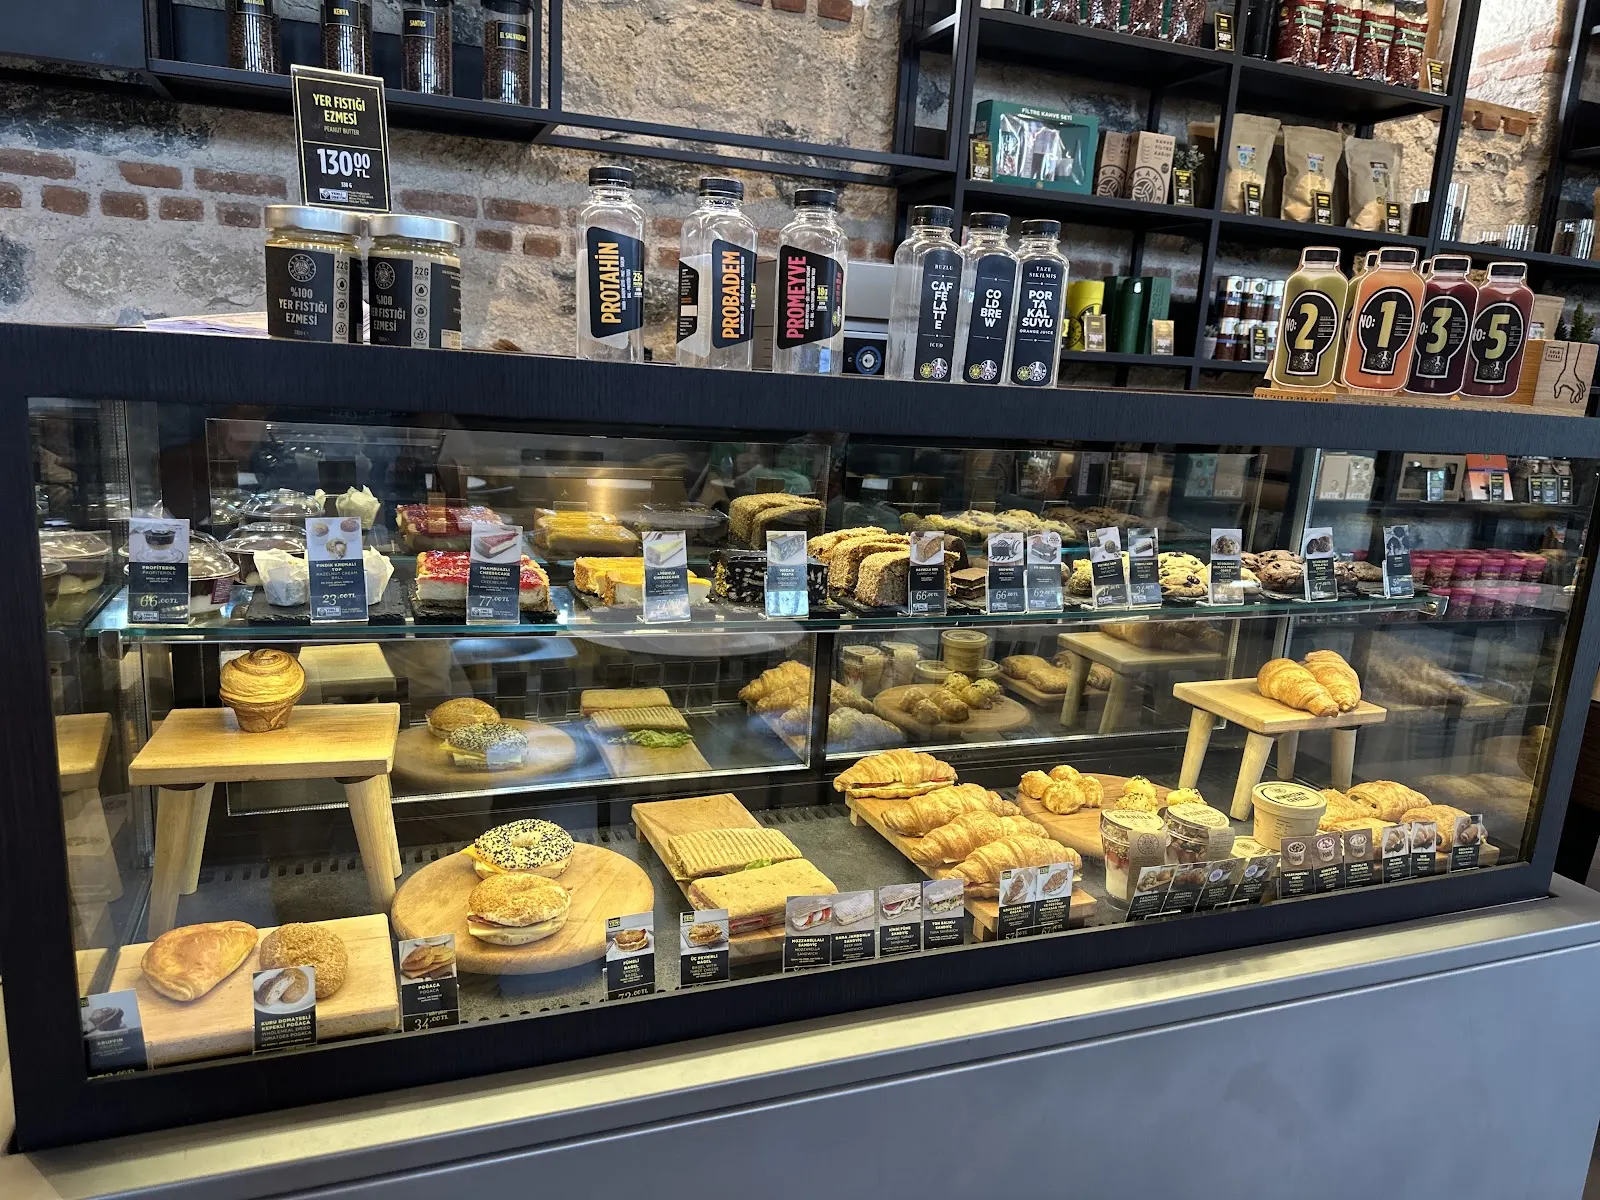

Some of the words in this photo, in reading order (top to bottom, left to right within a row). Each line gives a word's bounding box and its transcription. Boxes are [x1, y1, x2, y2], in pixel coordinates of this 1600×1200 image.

[409, 19, 426, 28] SANTOS
[505, 32, 527, 42] SALVADOR
[313, 93, 332, 108] YER
[334, 96, 366, 112] FISTIĞI
[324, 110, 358, 126] EZMESİ
[1021, 106, 1040, 116] FİLTRE
[1040, 110, 1060, 120] KAHVE
[1060, 113, 1073, 122] SETİ
[324, 126, 342, 134] PEANUT
[342, 128, 360, 136] BUTTER
[316, 148, 354, 177] 130
[353, 152, 371, 170] 00
[354, 168, 370, 178] TL
[336, 260, 349, 270] 22G
[414, 266, 429, 276] 22G
[594, 242, 622, 324] PROTAHİN
[931, 281, 954, 292] CAF
[290, 286, 314, 299] %100
[722, 251, 740, 338] PROBADEM
[786, 256, 806, 338] PROMEYVE
[986, 288, 1002, 300] CO
[1028, 290, 1053, 300] POR
[278, 298, 294, 310] YER
[294, 300, 328, 314] FISTIĞI
[933, 301, 948, 311] LA
[985, 298, 1000, 309] LD
[1032, 300, 1046, 310] TA
[379, 308, 406, 320] FISTIĞI
[933, 310, 946, 320] TT
[980, 308, 1002, 318] BRE
[1026, 308, 1050, 319] KAL
[286, 312, 318, 326] EZMESİ
[984, 318, 996, 328] W
[1022, 317, 1054, 328] SUYU
[1360, 314, 1376, 328] NO:
[1377, 301, 1397, 348] 1
[374, 320, 397, 332] EZMESİ
[934, 320, 942, 330] E
[1286, 318, 1298, 332] NO:
[1294, 303, 1318, 350] 2
[1426, 308, 1452, 354] 3
[1485, 314, 1510, 360] 5
[322, 594, 337, 606] 23
[916, 590, 927, 600] 66
[995, 590, 1007, 600] 66
[140, 594, 158, 608] 66
[278, 1014, 311, 1023] DOMATESLİ
[414, 1018, 430, 1032] 34
